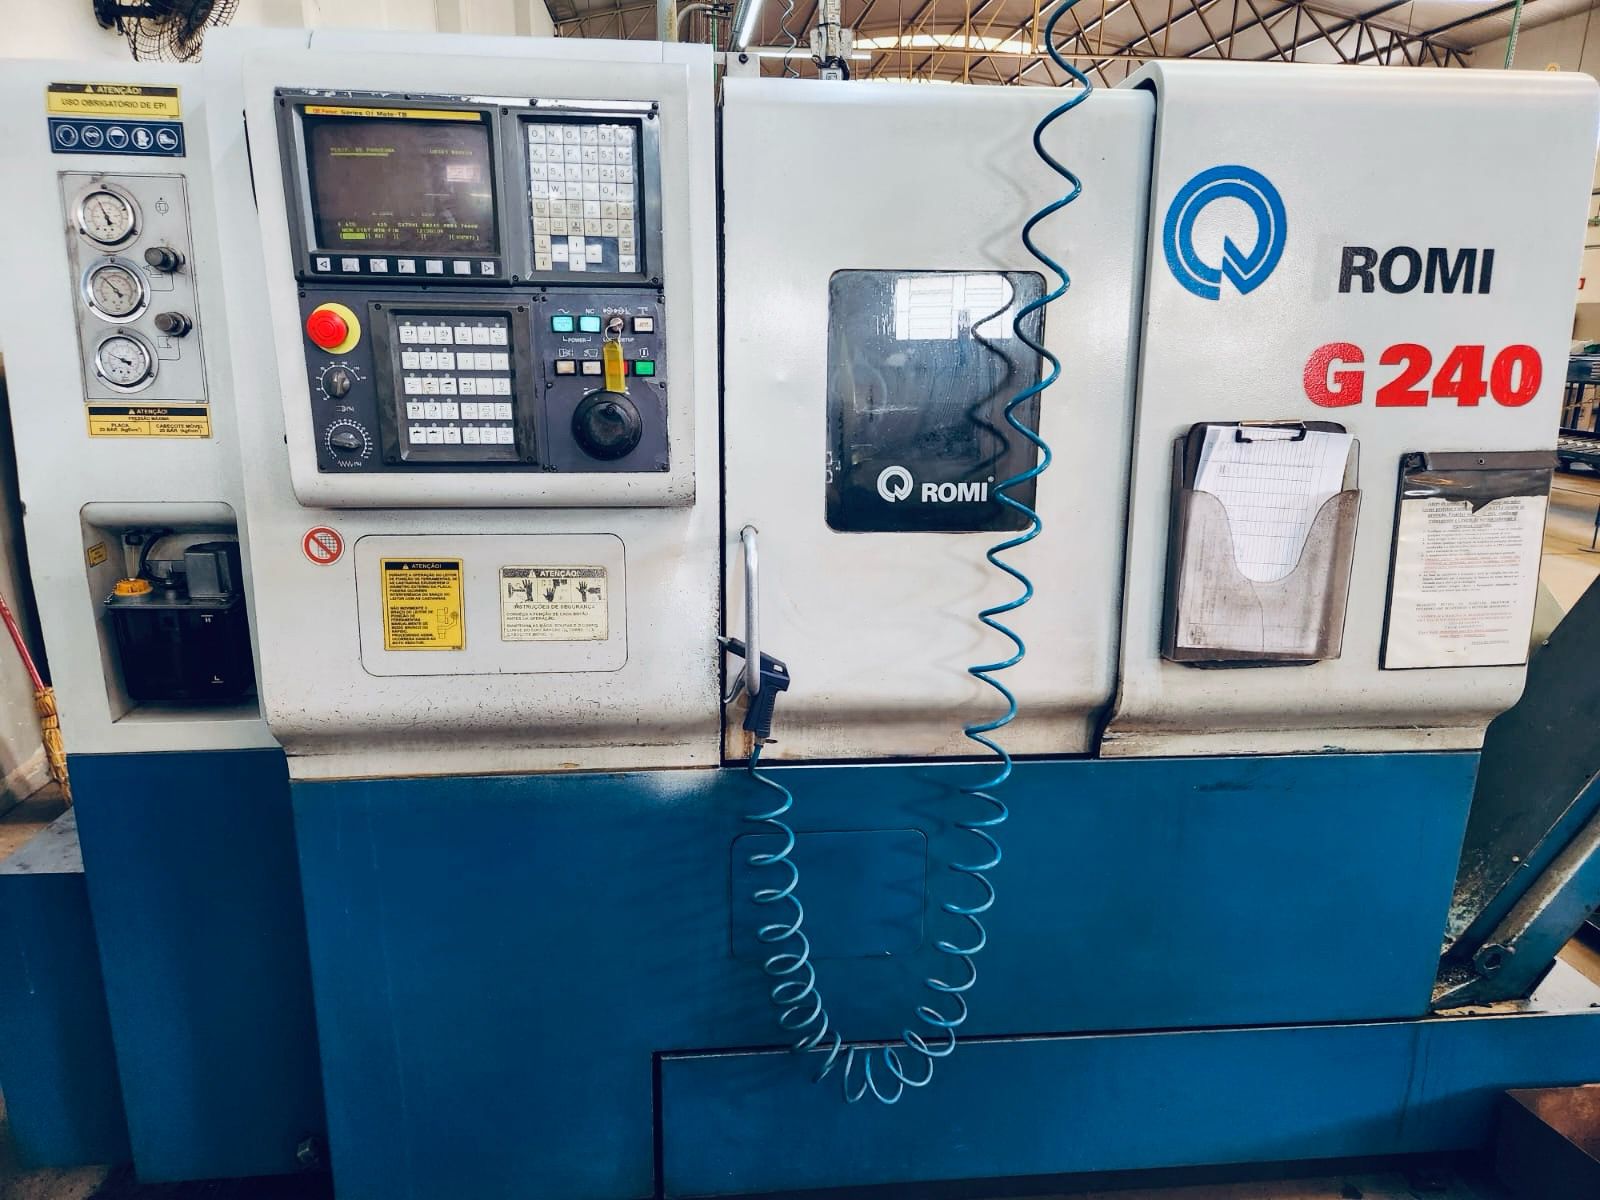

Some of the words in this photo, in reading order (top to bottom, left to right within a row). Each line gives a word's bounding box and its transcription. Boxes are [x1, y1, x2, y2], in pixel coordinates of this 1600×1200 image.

[96, 86, 142, 95] ATENÇÃO!
[1338, 246, 1495, 294] ROMI
[921, 482, 988, 502] ROMI
